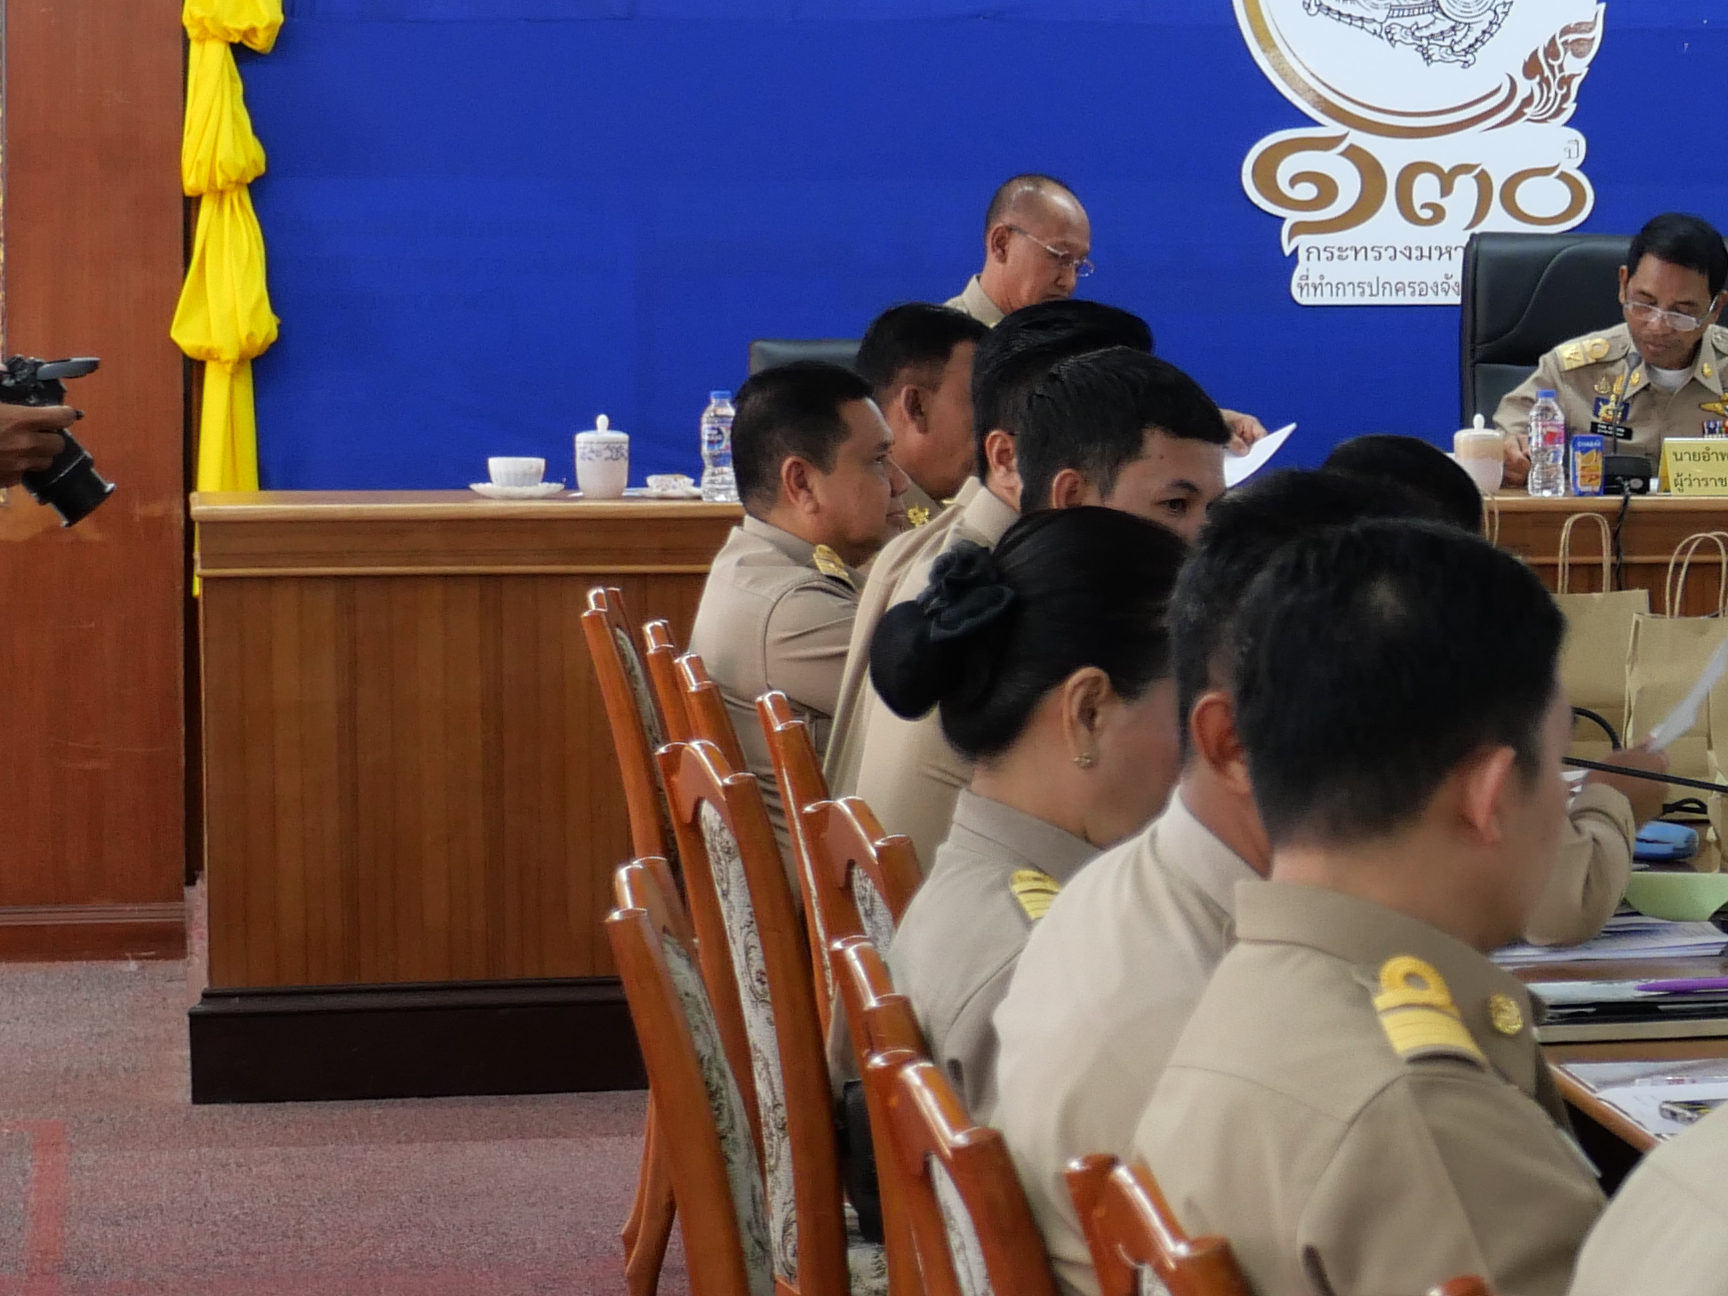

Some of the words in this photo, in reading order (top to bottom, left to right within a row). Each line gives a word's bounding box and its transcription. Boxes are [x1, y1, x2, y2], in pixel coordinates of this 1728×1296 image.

[1252, 131, 1587, 245] ๑๓๐
[1297, 268, 1461, 298] ที่ทำการปกครองจัง
